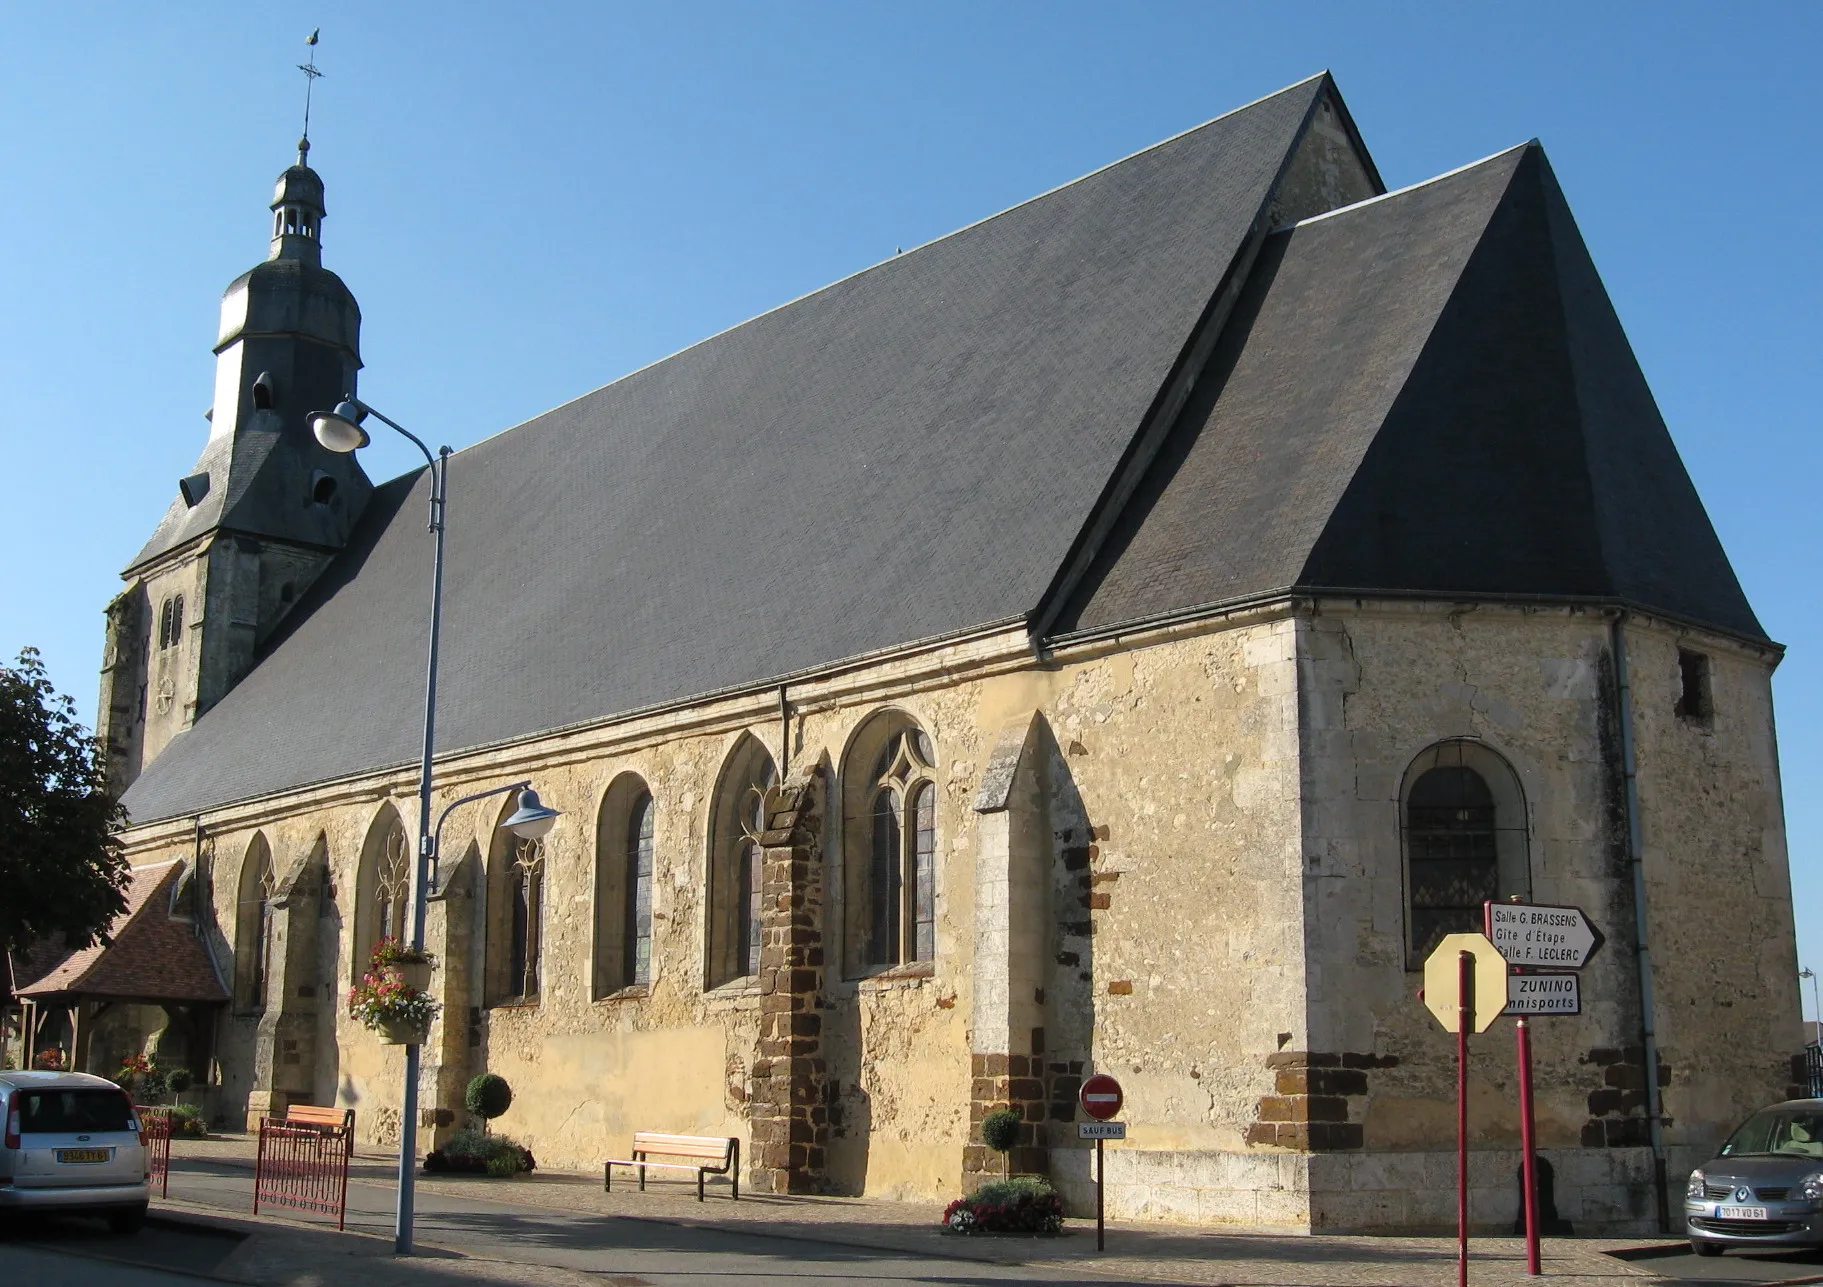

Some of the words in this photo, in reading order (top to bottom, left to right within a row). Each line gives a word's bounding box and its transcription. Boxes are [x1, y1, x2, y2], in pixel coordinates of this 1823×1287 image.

[1495, 911, 1516, 923] Salle
[1519, 912, 1528, 924] G.
[1531, 913, 1577, 927] BRASSENS
[1525, 947, 1534, 958] F.
[1538, 948, 1579, 960] LECLERC
[1519, 980, 1573, 993] ZUNINO
[1083, 1126, 1104, 1134] SAUF
[1753, 1208, 1764, 1217] 61
